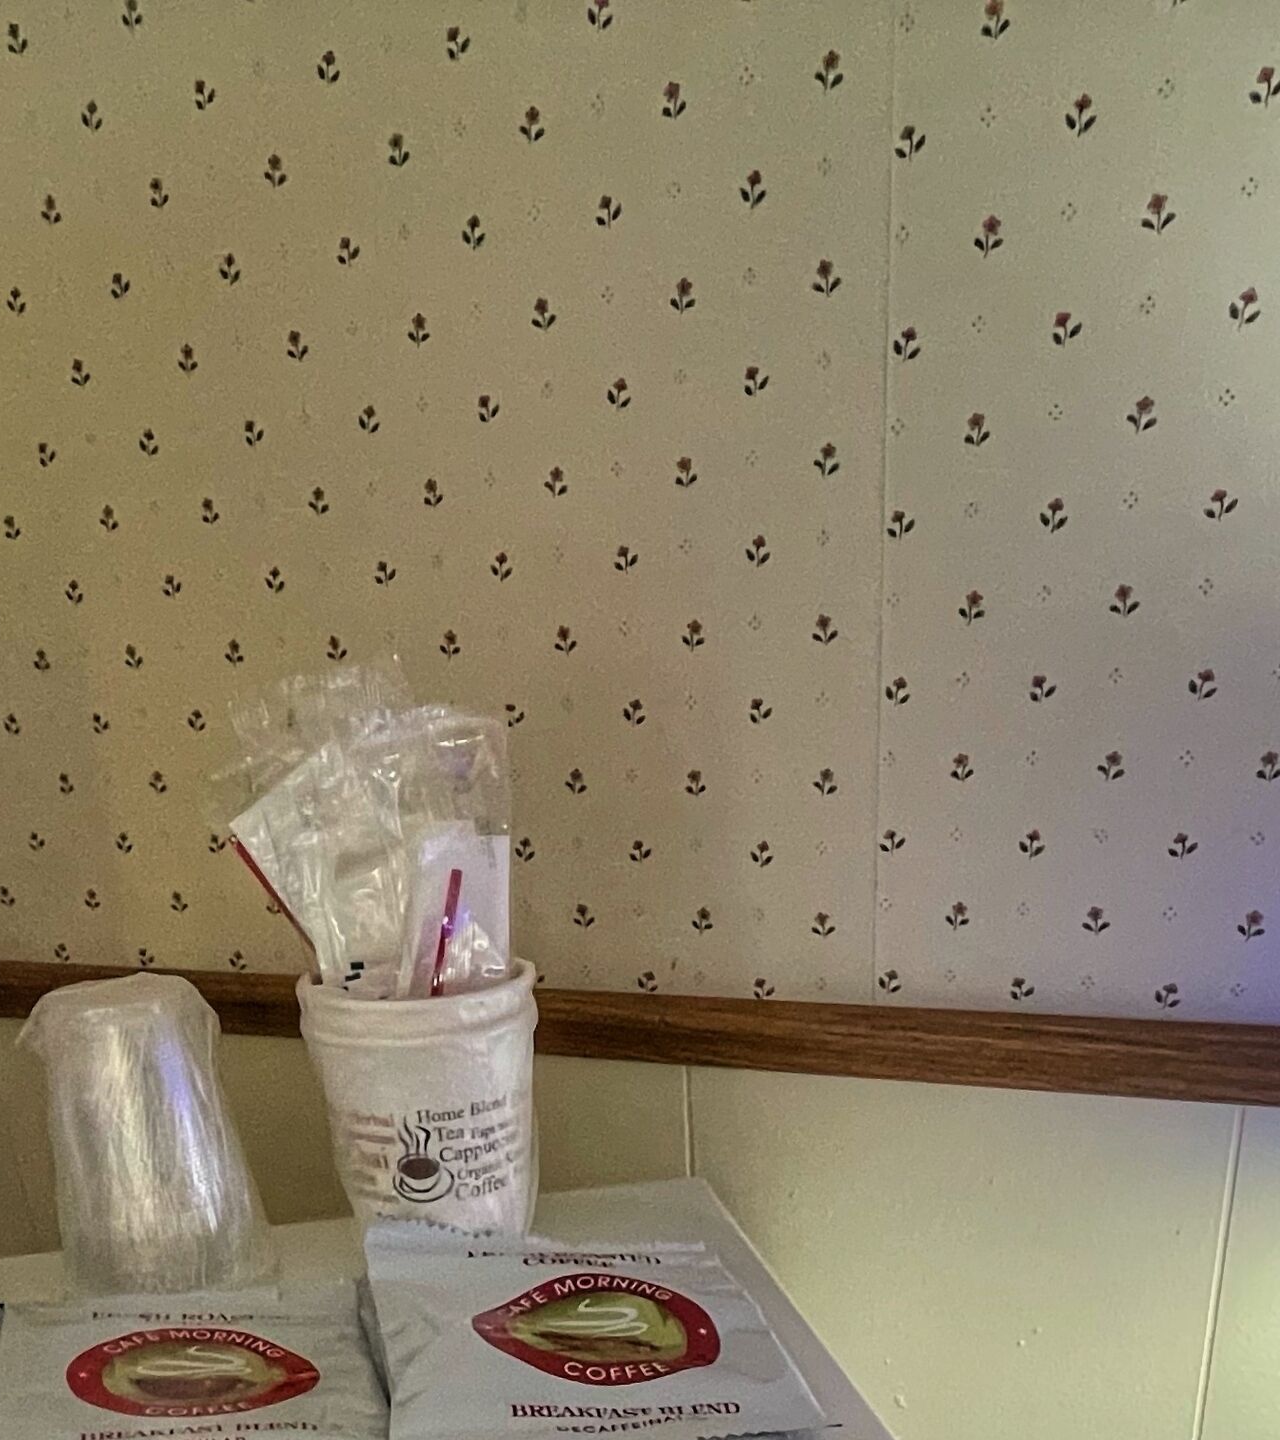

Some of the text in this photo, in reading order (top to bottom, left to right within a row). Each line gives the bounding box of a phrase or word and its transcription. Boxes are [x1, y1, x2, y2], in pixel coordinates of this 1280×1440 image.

[417, 1108, 465, 1124] Home
[434, 1126, 465, 1142] Tea
[553, 1276, 673, 1301] MORNING
[170, 1330, 286, 1358] MORNING
[564, 1360, 670, 1380] COFFEE
[144, 1401, 254, 1416] COFFEE
[511, 1404, 653, 1419] BREAKFAST
